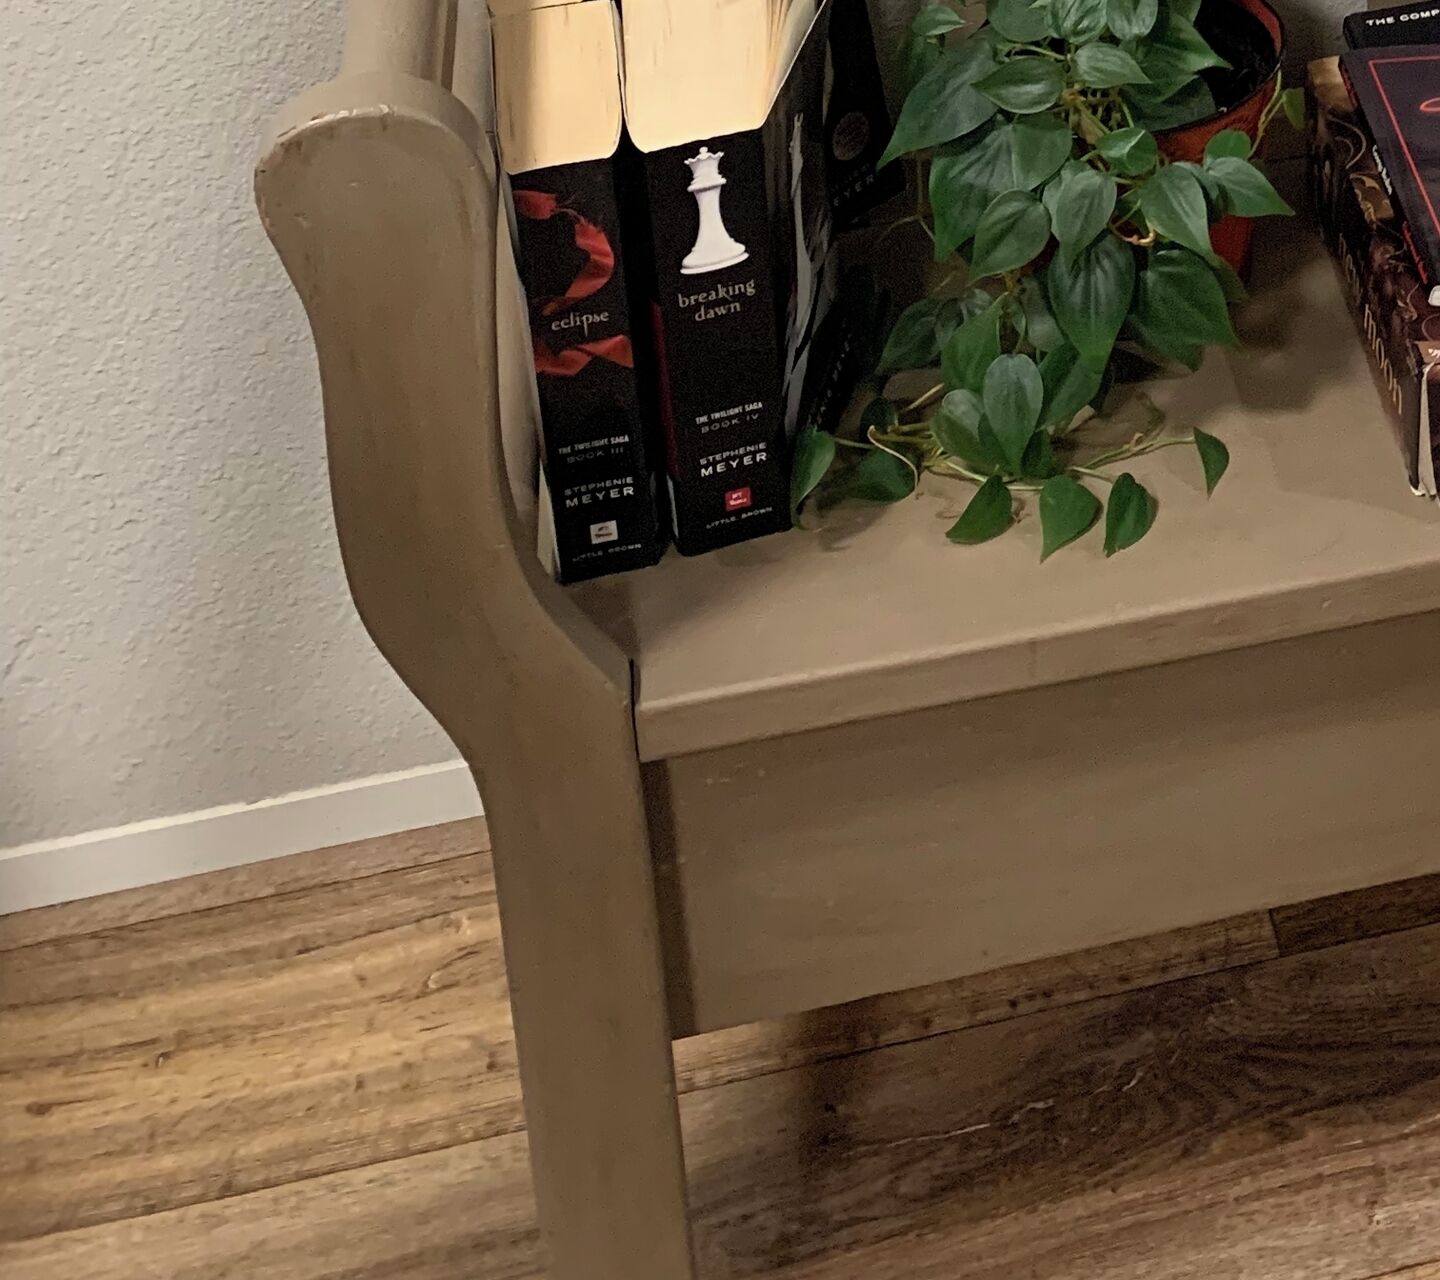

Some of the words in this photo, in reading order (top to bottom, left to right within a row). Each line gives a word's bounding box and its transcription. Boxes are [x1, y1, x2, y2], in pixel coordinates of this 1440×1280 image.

[1365, 15, 1396, 27] THE
[678, 279, 757, 309] breaking
[694, 299, 741, 322] dawn
[551, 309, 610, 337] eclipse
[1364, 303, 1402, 416] moon
[695, 415, 710, 426] THE
[710, 405, 743, 421] TWILIGHT
[744, 401, 764, 412] SAGA
[700, 418, 741, 434] BOOK
[747, 412, 760, 422] IV
[558, 445, 572, 456] THE
[574, 437, 610, 452] TWILIGHT
[611, 434, 630, 444] SAGA
[699, 441, 767, 466] STEPHENIE
[700, 451, 768, 478] MEYER
[564, 476, 634, 497] STEPHENIE
[565, 486, 635, 509] MEYER
